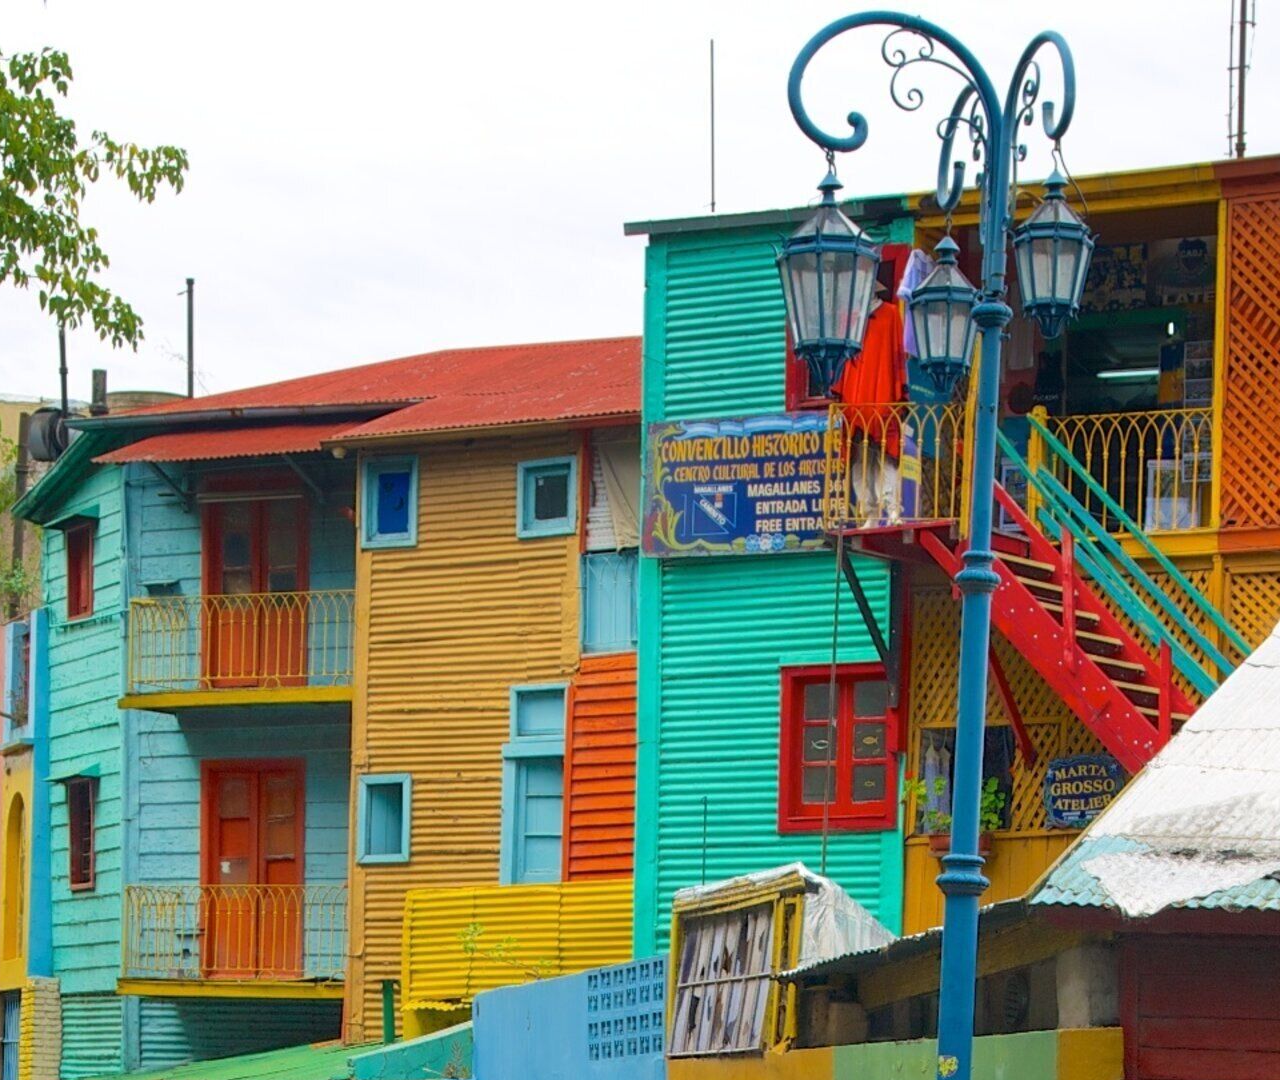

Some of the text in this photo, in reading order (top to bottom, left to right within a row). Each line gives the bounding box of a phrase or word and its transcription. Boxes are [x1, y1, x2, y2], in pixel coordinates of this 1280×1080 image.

[662, 436, 750, 463] CONVENTILLO
[752, 431, 819, 458] HISTORICO
[674, 458, 845, 482] CENTRO CULTURAL DE LOS ARTISAS
[747, 480, 821, 497] MAGALLANES
[755, 497, 847, 515] ENTRADA LIRE
[755, 516, 847, 533] FREE ENTRAC
[1055, 764, 1108, 781] MARTA
[1051, 778, 1116, 796] GROSSO
[1053, 794, 1111, 811] ATELIER
